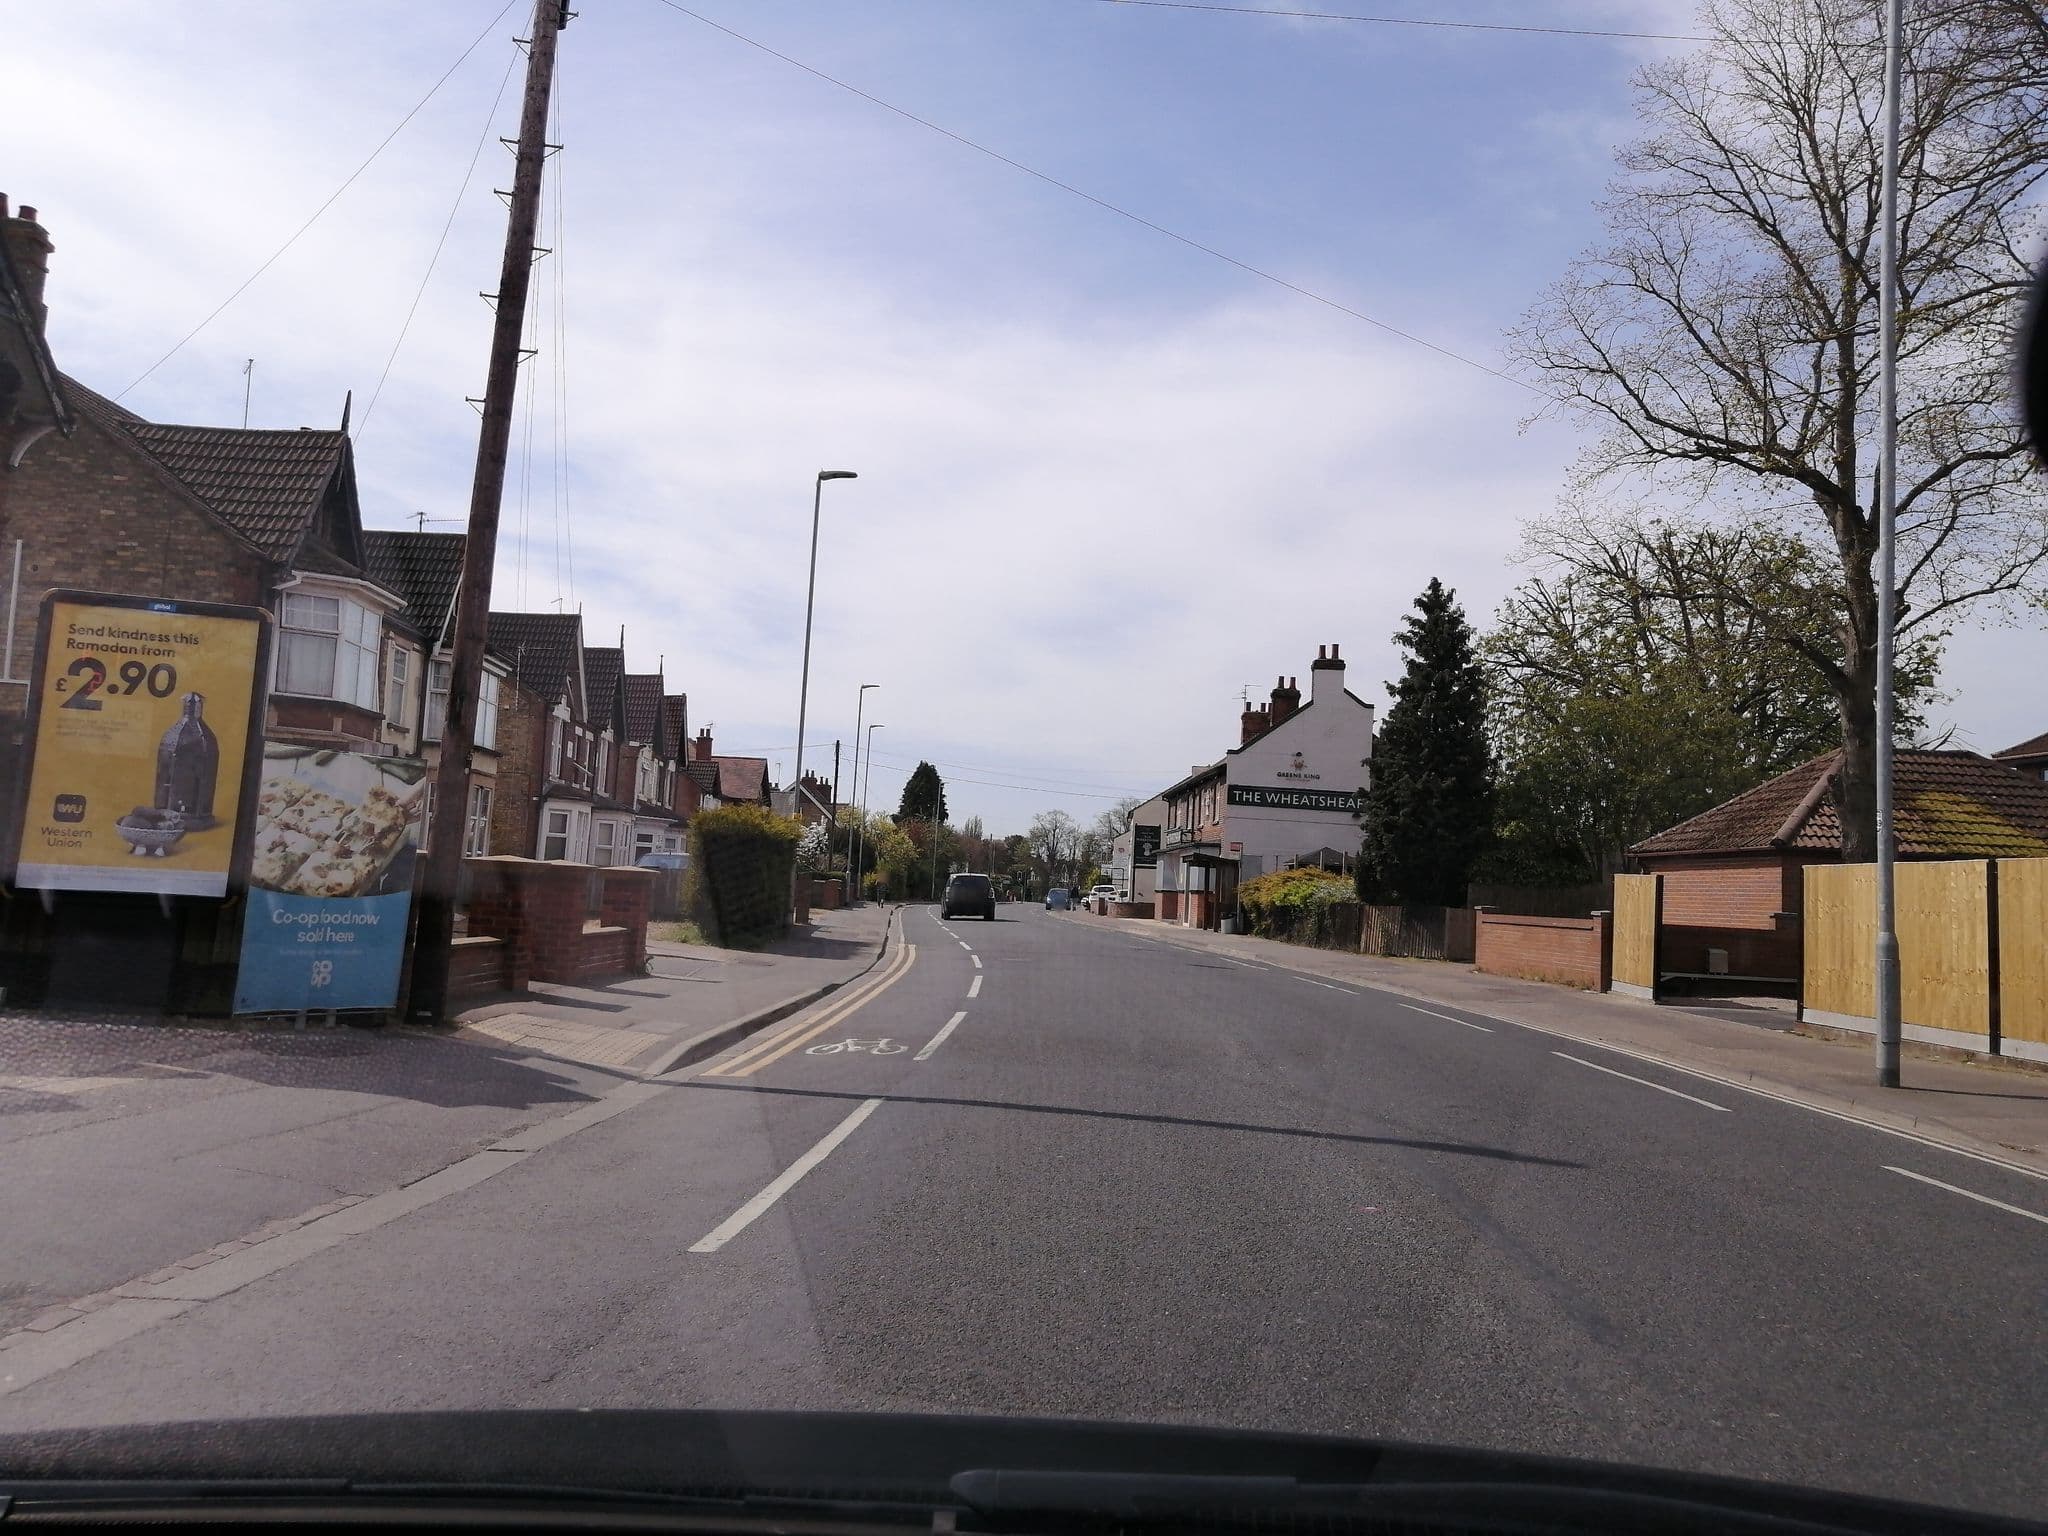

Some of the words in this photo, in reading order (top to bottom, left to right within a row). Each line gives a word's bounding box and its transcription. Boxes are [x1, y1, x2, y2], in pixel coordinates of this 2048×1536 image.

[68, 623, 105, 637] Send
[108, 627, 170, 643] kindness
[173, 633, 200, 646] this
[66, 638, 138, 655] Ramadan
[141, 645, 176, 658] from
[1276, 771, 1302, 779] GREENE
[1233, 790, 1262, 803] THE
[1265, 792, 1363, 809] WHEATSHEAF
[41, 826, 93, 838] Western
[47, 838, 83, 848] Union
[272, 908, 319, 928] Co-op
[319, 908, 351, 925] food
[351, 912, 380, 925] now
[297, 927, 325, 942] sold
[326, 927, 355, 942] here
